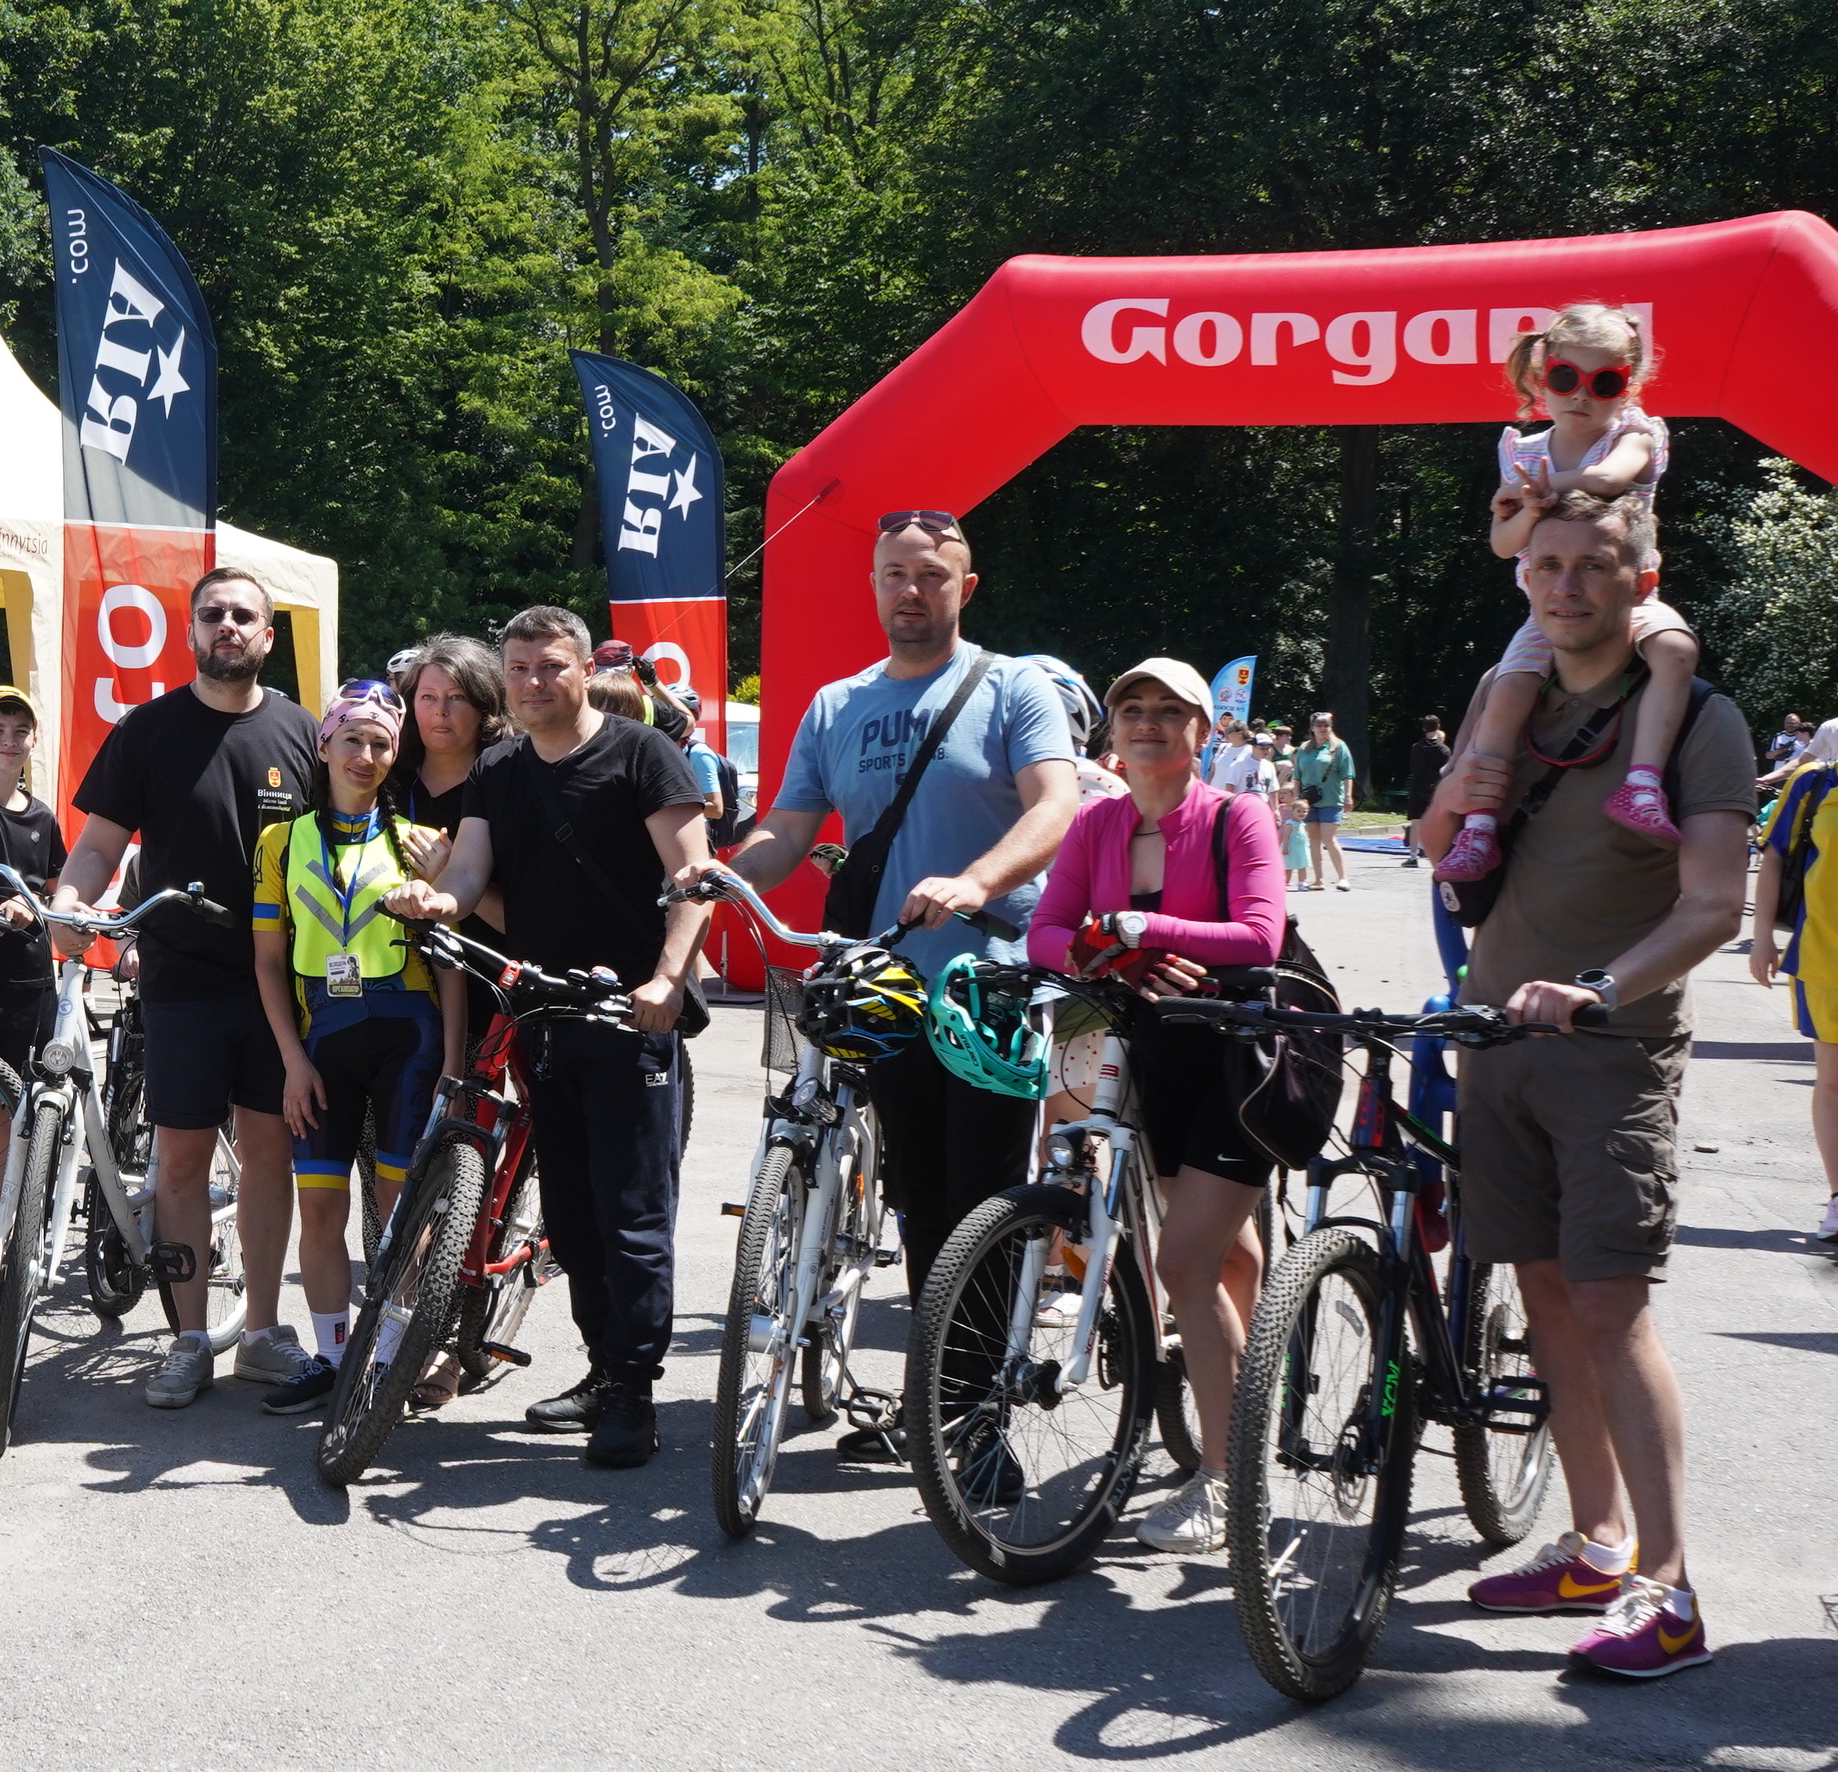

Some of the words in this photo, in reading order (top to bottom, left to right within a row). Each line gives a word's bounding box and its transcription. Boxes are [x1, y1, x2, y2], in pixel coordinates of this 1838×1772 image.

[859, 753, 905, 773] SPORTS
[258, 789, 292, 799] Вінниця
[645, 1072, 668, 1085] EA7
